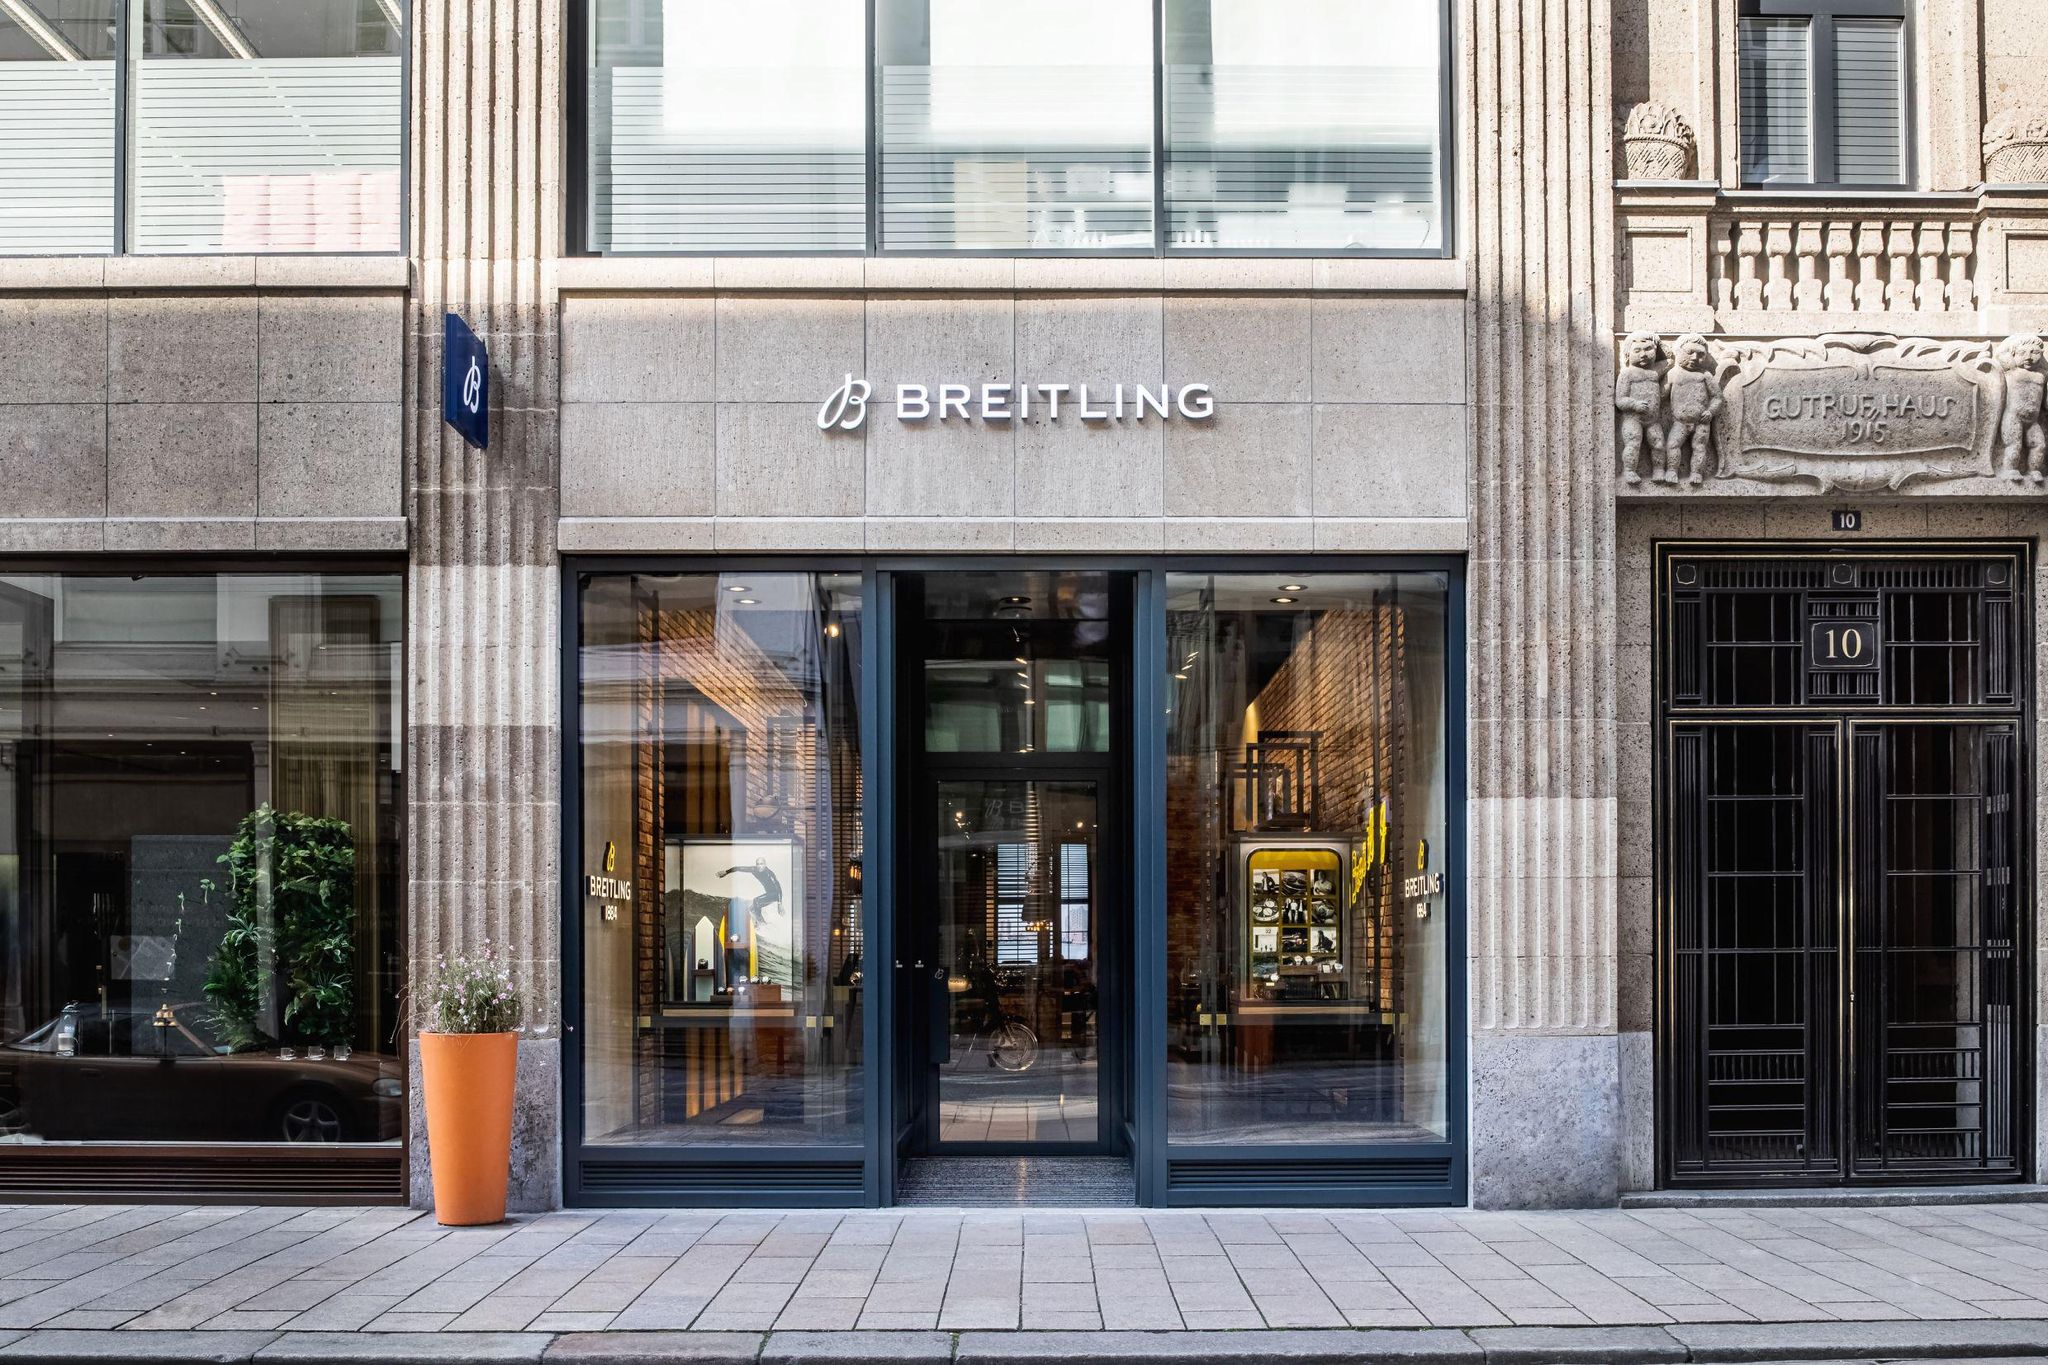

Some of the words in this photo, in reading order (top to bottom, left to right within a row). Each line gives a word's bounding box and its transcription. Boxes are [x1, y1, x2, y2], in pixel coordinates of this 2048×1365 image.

[897, 383, 1214, 419] BREITLING
[1839, 421, 1888, 443] 1915
[1840, 513, 1855, 528] 10
[1824, 628, 1862, 658] 10
[590, 875, 631, 900] BREITLING
[1405, 872, 1440, 898] BREITLING
